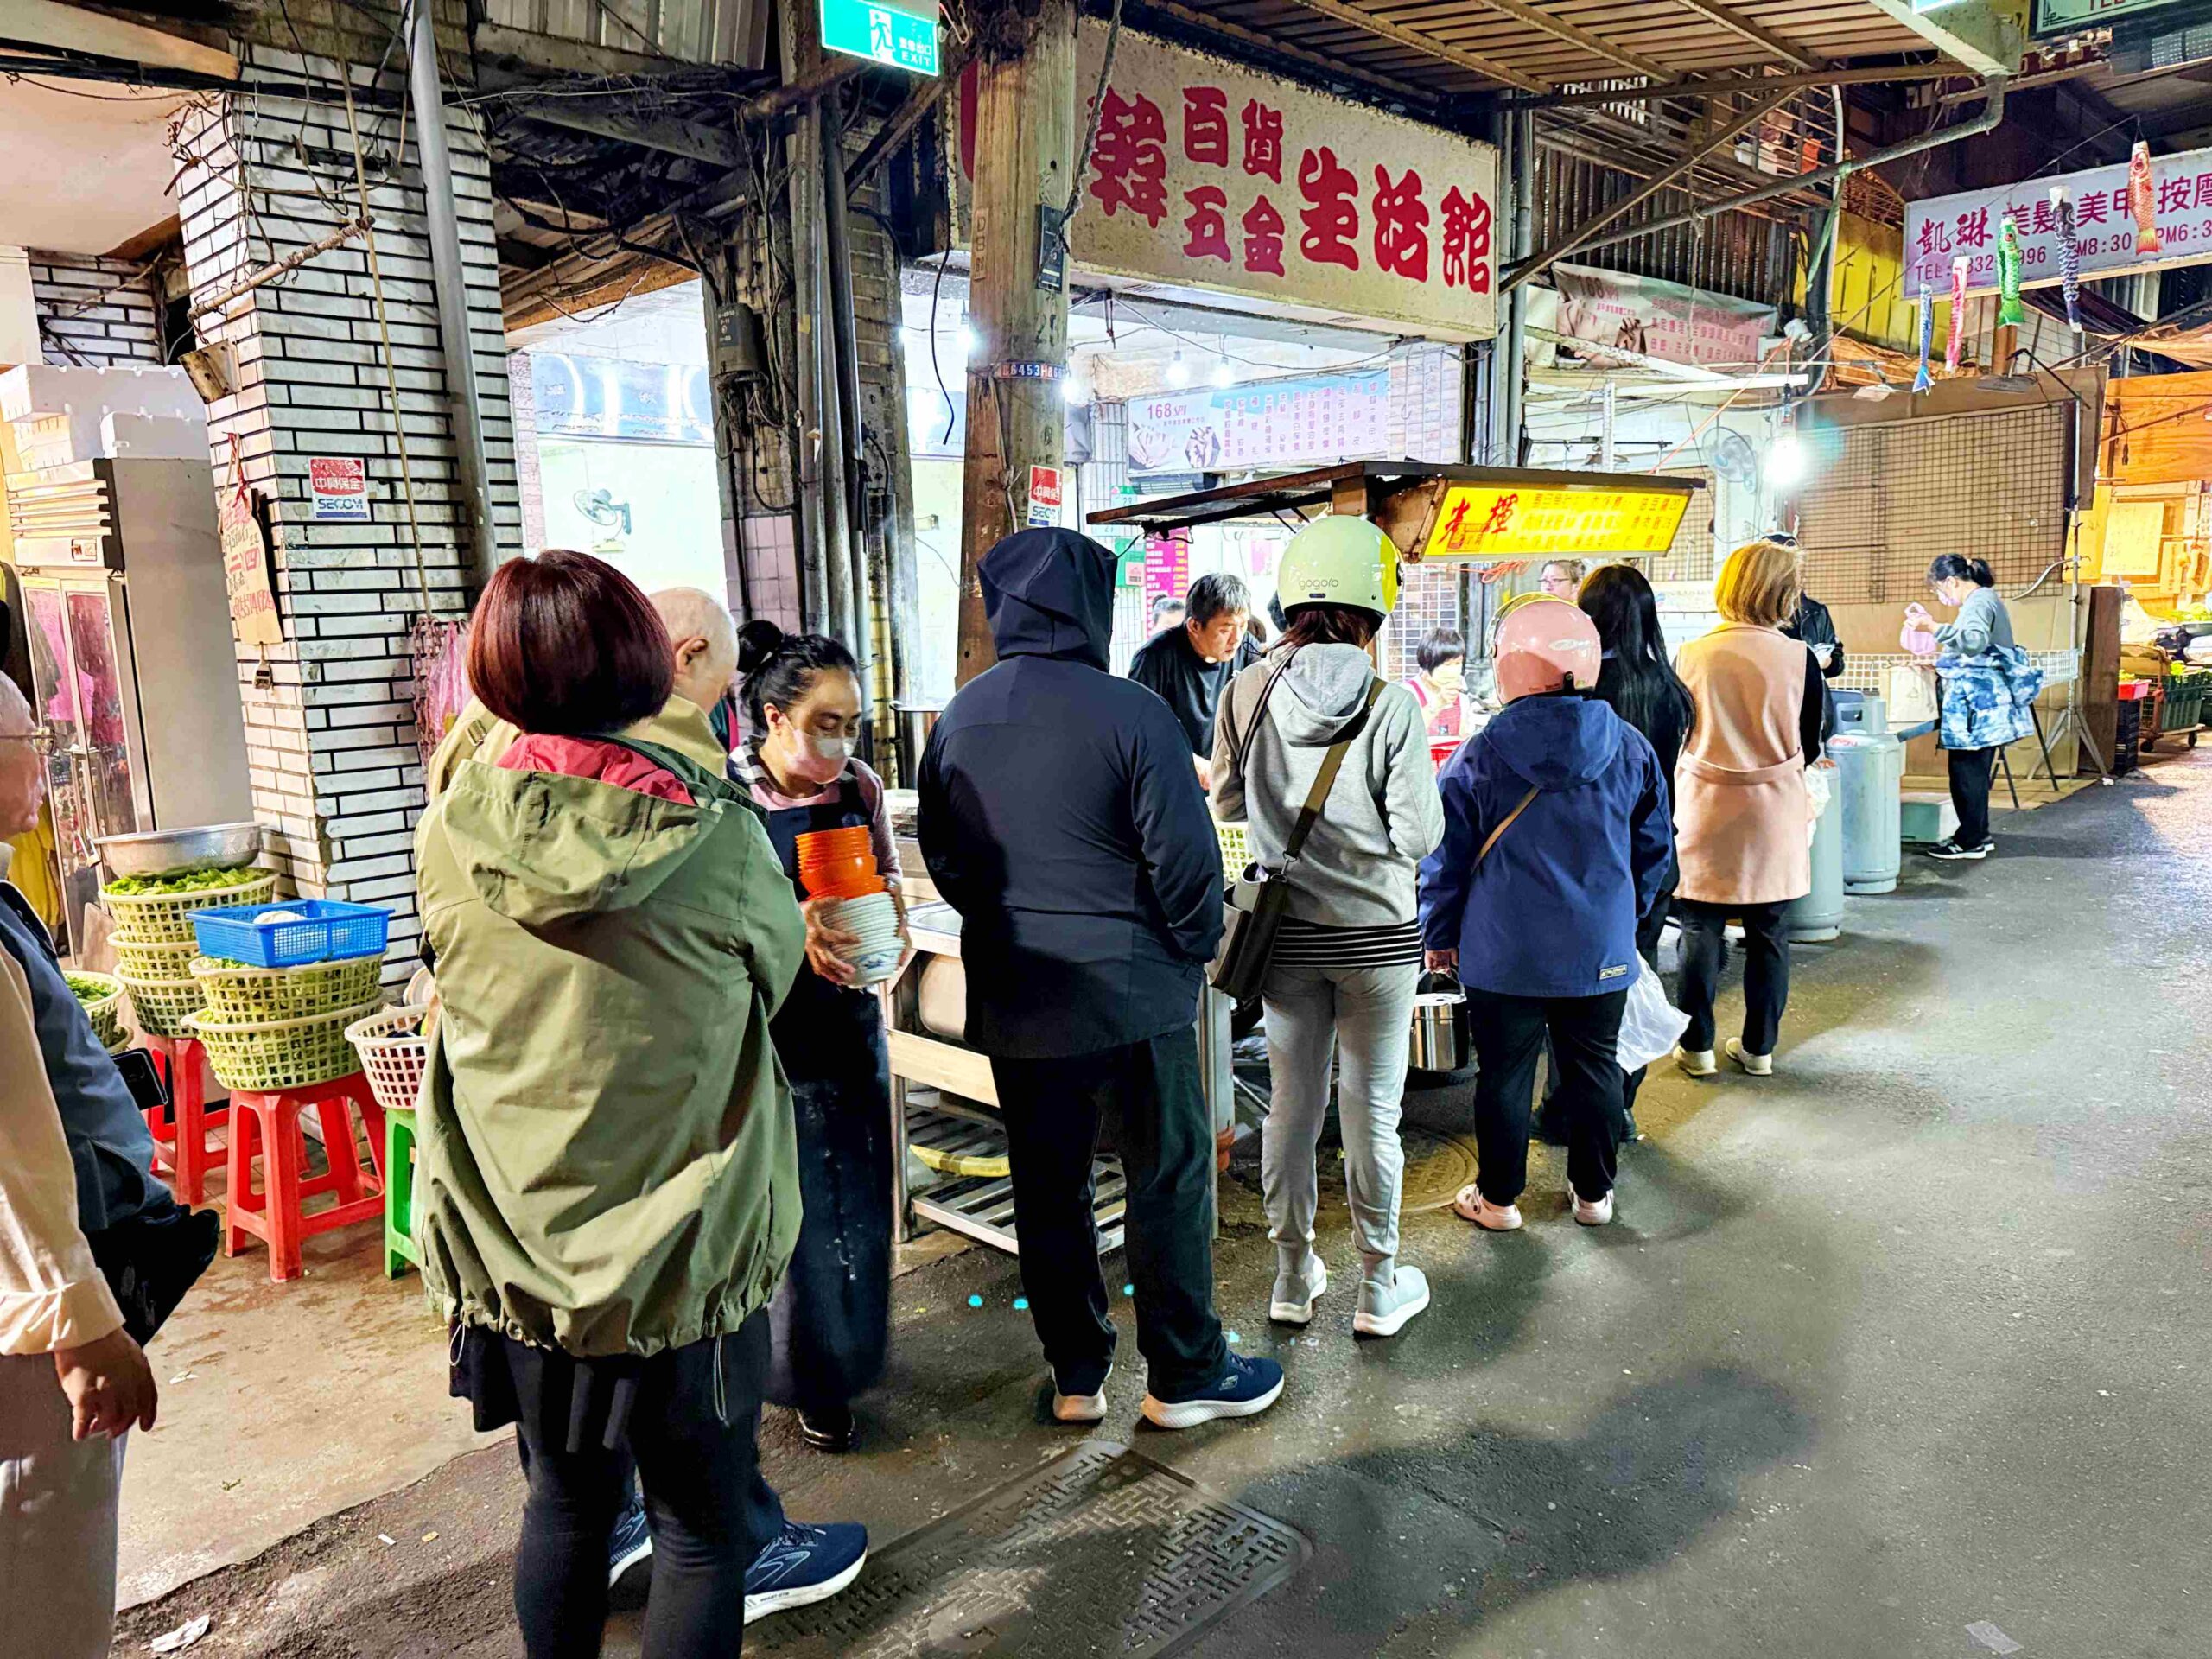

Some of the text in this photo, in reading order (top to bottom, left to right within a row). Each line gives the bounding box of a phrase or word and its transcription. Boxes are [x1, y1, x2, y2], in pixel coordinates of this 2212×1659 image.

[901, 50, 931, 67] EXIT
[1184, 87, 1284, 184] 百貨
[1184, 186, 1286, 277] 五金
[1299, 146, 1492, 295] 生活館
[1916, 207, 1993, 257] 凱琳
[1147, 403, 1172, 420] 168
[1299, 578, 1339, 590] gogoro
